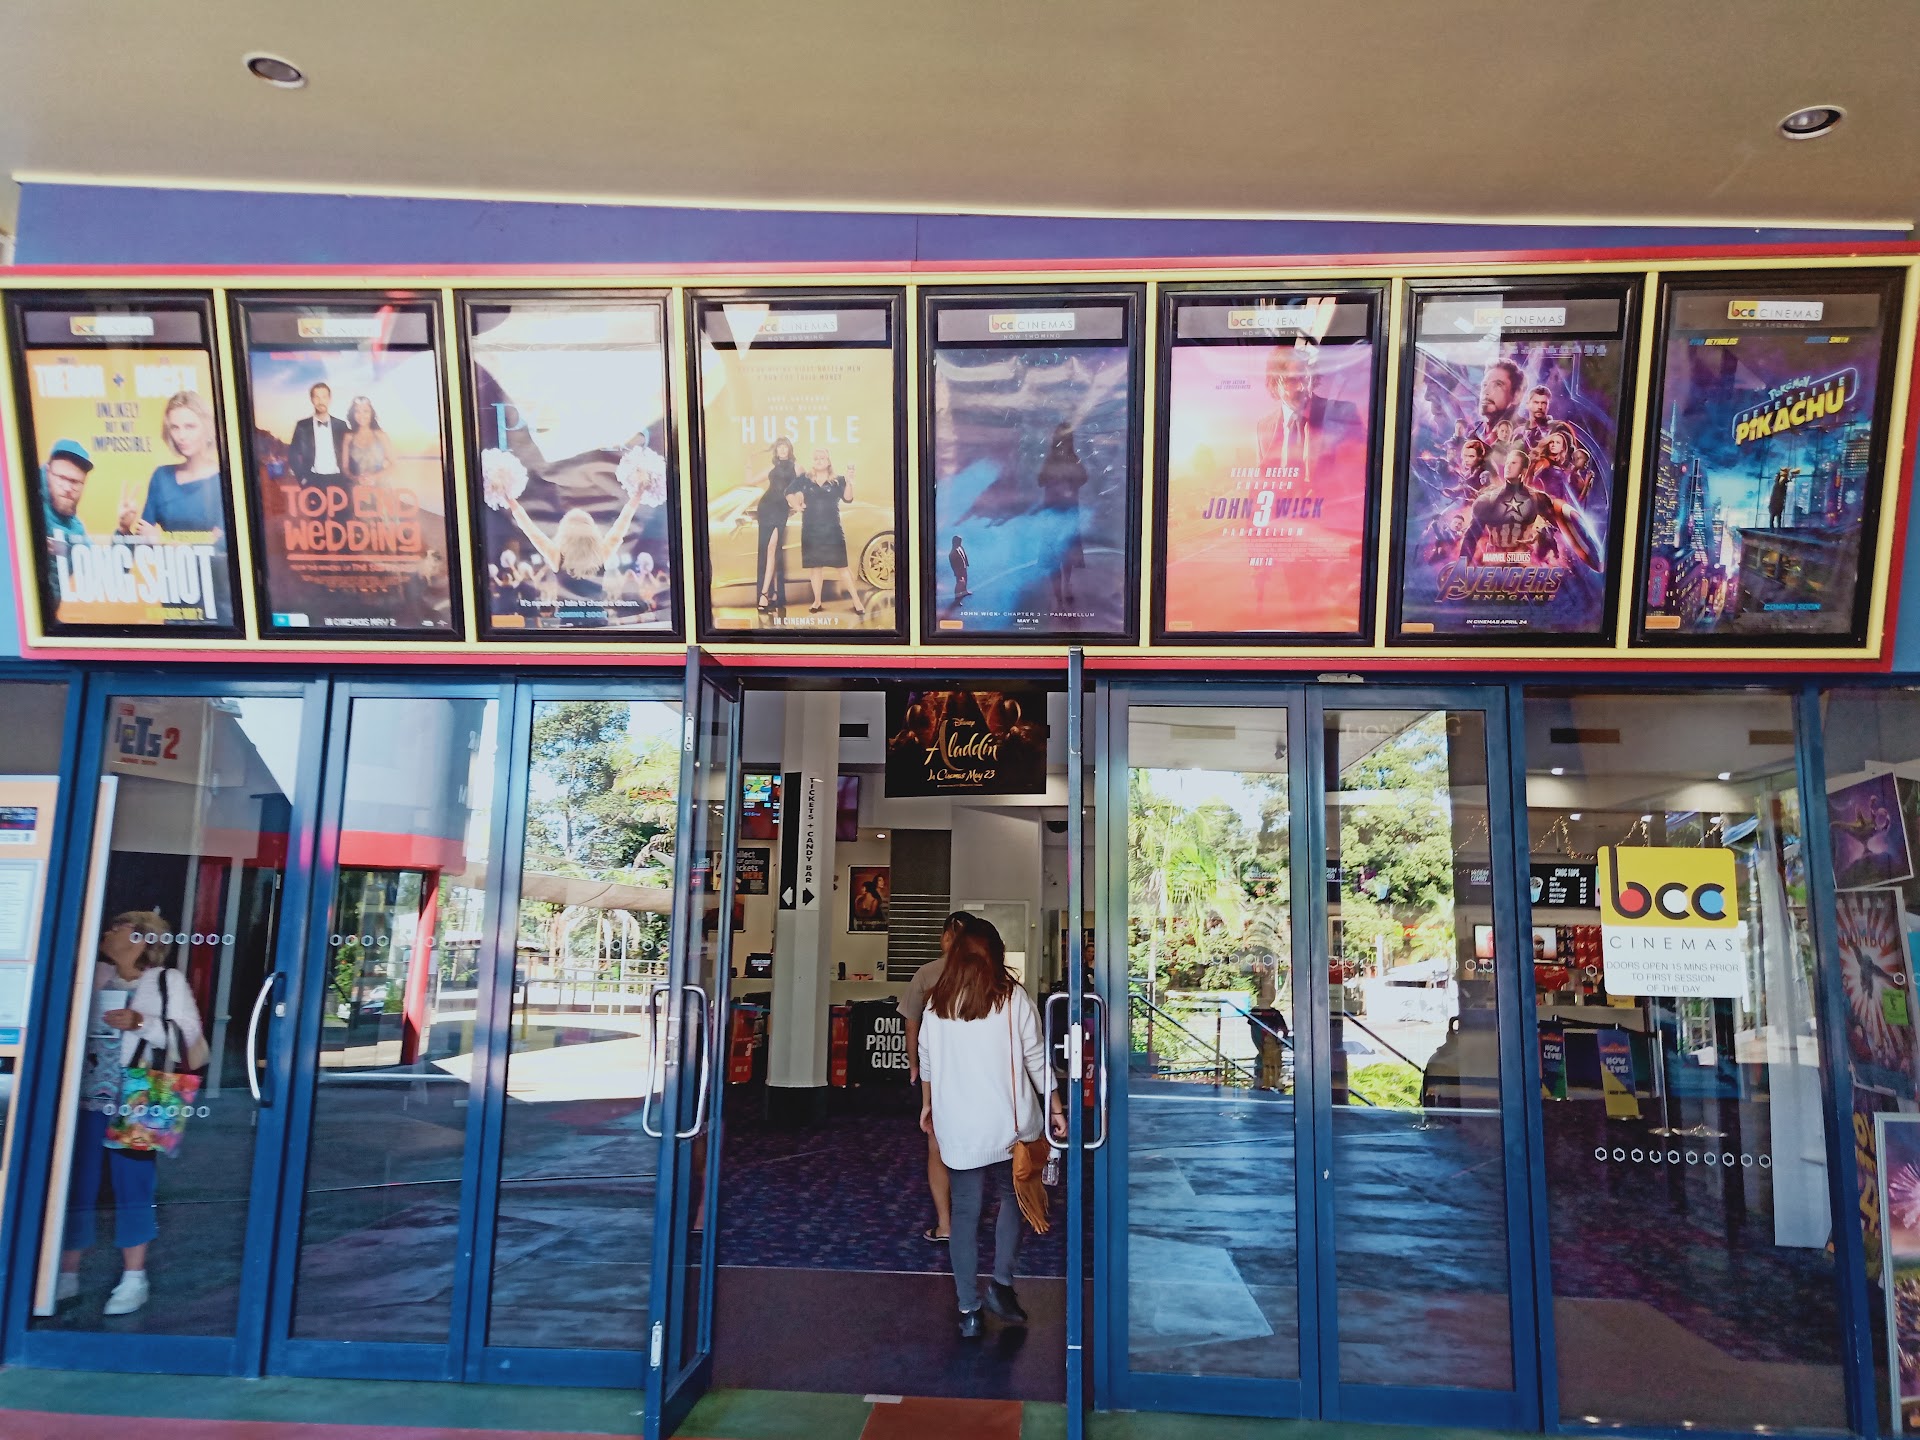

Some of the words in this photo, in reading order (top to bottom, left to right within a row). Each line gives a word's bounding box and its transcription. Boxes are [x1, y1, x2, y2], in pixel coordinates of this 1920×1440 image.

[1732, 302, 1756, 317] bcc
[1760, 309, 1820, 319] CINEMAS
[781, 320, 837, 331] CINEMAS
[991, 314, 1014, 331] bcc
[1018, 320, 1073, 330] CINEMAS
[1231, 311, 1254, 327] bcc
[1504, 315, 1563, 325] CINEMAS
[742, 416, 860, 444] HUSTLE
[93, 436, 152, 452] IMPOSSIBLE
[1231, 468, 1260, 477] KEANU
[1266, 467, 1299, 478] REEVES
[280, 485, 349, 518] TOP
[352, 484, 419, 518] END
[1202, 497, 1254, 519] JOHN
[1253, 490, 1274, 527] 3
[1276, 498, 1324, 518] WICK
[1222, 528, 1303, 537] PARABELLUM
[1249, 558, 1263, 566] MAY
[1483, 553, 1505, 562] MARVEL
[1507, 552, 1531, 562] STUDIOS
[53, 528, 137, 604] LONG
[134, 545, 218, 619] SHOT
[1435, 556, 1564, 602] AVENGERS
[1763, 603, 1796, 611] COMING
[1797, 603, 1822, 611] SOON
[773, 617, 782, 625] IN
[784, 617, 815, 626] CINEMAS
[817, 617, 832, 626] MAY
[952, 717, 976, 728] Disney
[163, 727, 180, 760] 2
[924, 719, 998, 772] Aladdin
[966, 769, 984, 783] May
[984, 769, 996, 779] 23
[808, 777, 816, 820] TICKETS
[805, 831, 814, 862] CANDY
[736, 864, 758, 872] ickets
[743, 872, 763, 880] HERE
[805, 865, 813, 884] BAR
[1608, 845, 1727, 920] bcc
[1609, 936, 1733, 951] CINEMAS
[1606, 961, 1640, 970] DOORS
[1642, 962, 1669, 971] OPEN
[1672, 963, 1682, 971] 15
[1684, 963, 1707, 972] MINS
[1709, 963, 1739, 972] PRIOR
[1632, 973, 1644, 981] TO
[1646, 973, 1672, 982] FIRST
[1674, 974, 1715, 983] SESSION
[1646, 984, 1660, 992] OF
[1682, 985, 1701, 993] DAY
[874, 1017, 905, 1034] ONL
[866, 1034, 906, 1051] PRIO
[871, 1052, 910, 1069] GUES
